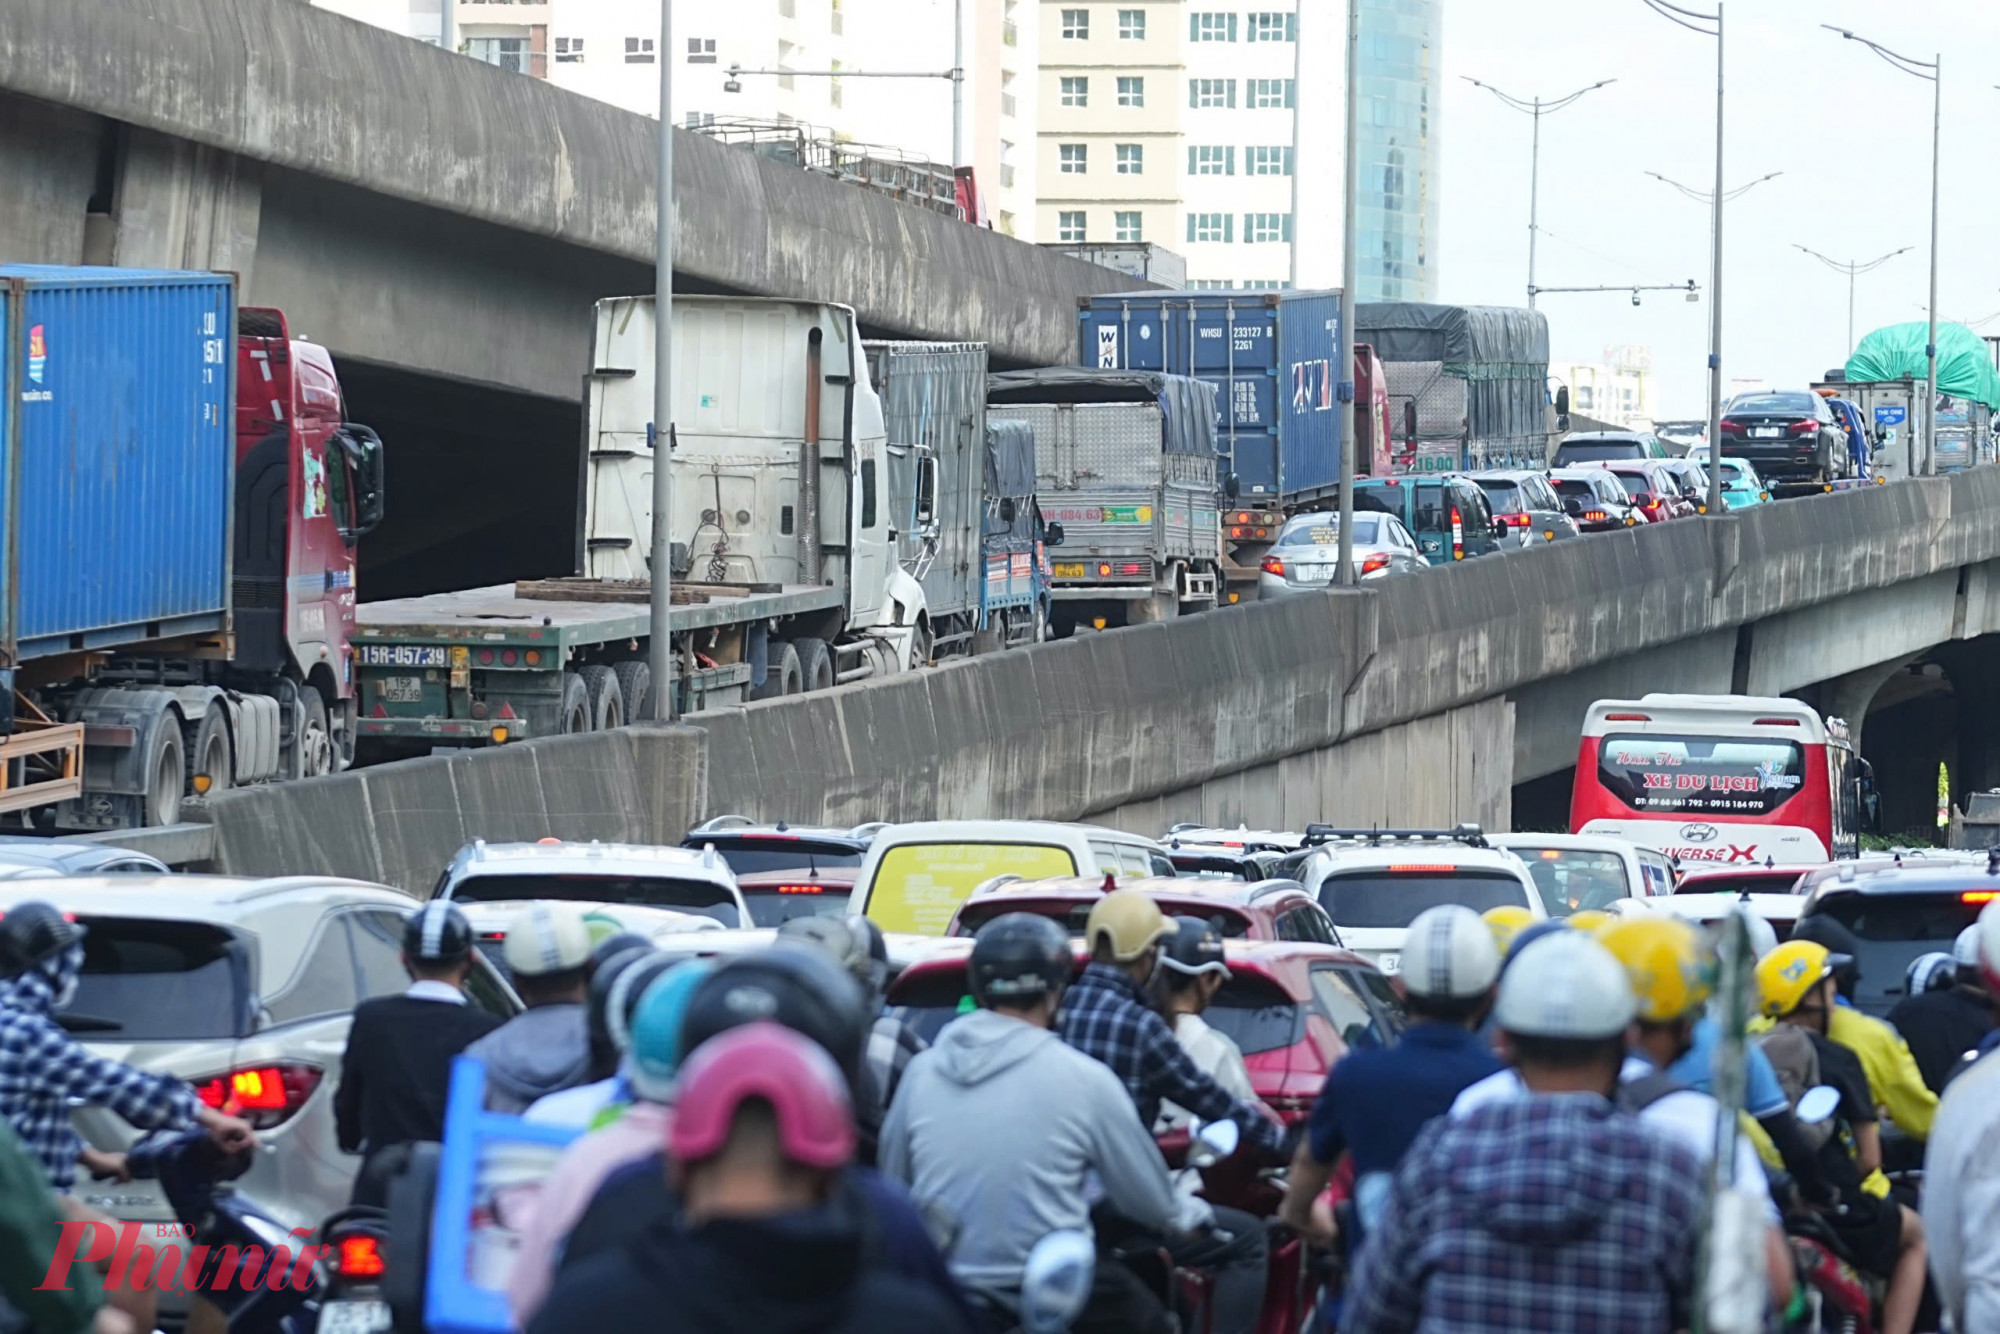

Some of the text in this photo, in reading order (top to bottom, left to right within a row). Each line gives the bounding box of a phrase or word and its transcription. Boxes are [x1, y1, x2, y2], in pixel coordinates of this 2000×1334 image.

[1200, 327, 1222, 338] WHSU
[1233, 327, 1262, 338] 233127
[362, 645, 446, 666] 15R-057.39
[1643, 773, 1672, 788] XE
[1676, 774, 1706, 789] DU
[1711, 775, 1758, 795] LỊCH
[1648, 798, 1658, 806] 09
[1688, 799, 1703, 807] 792
[1710, 799, 1731, 808] 0915
[1733, 800, 1747, 808] 184
[1748, 800, 1764, 809] 970
